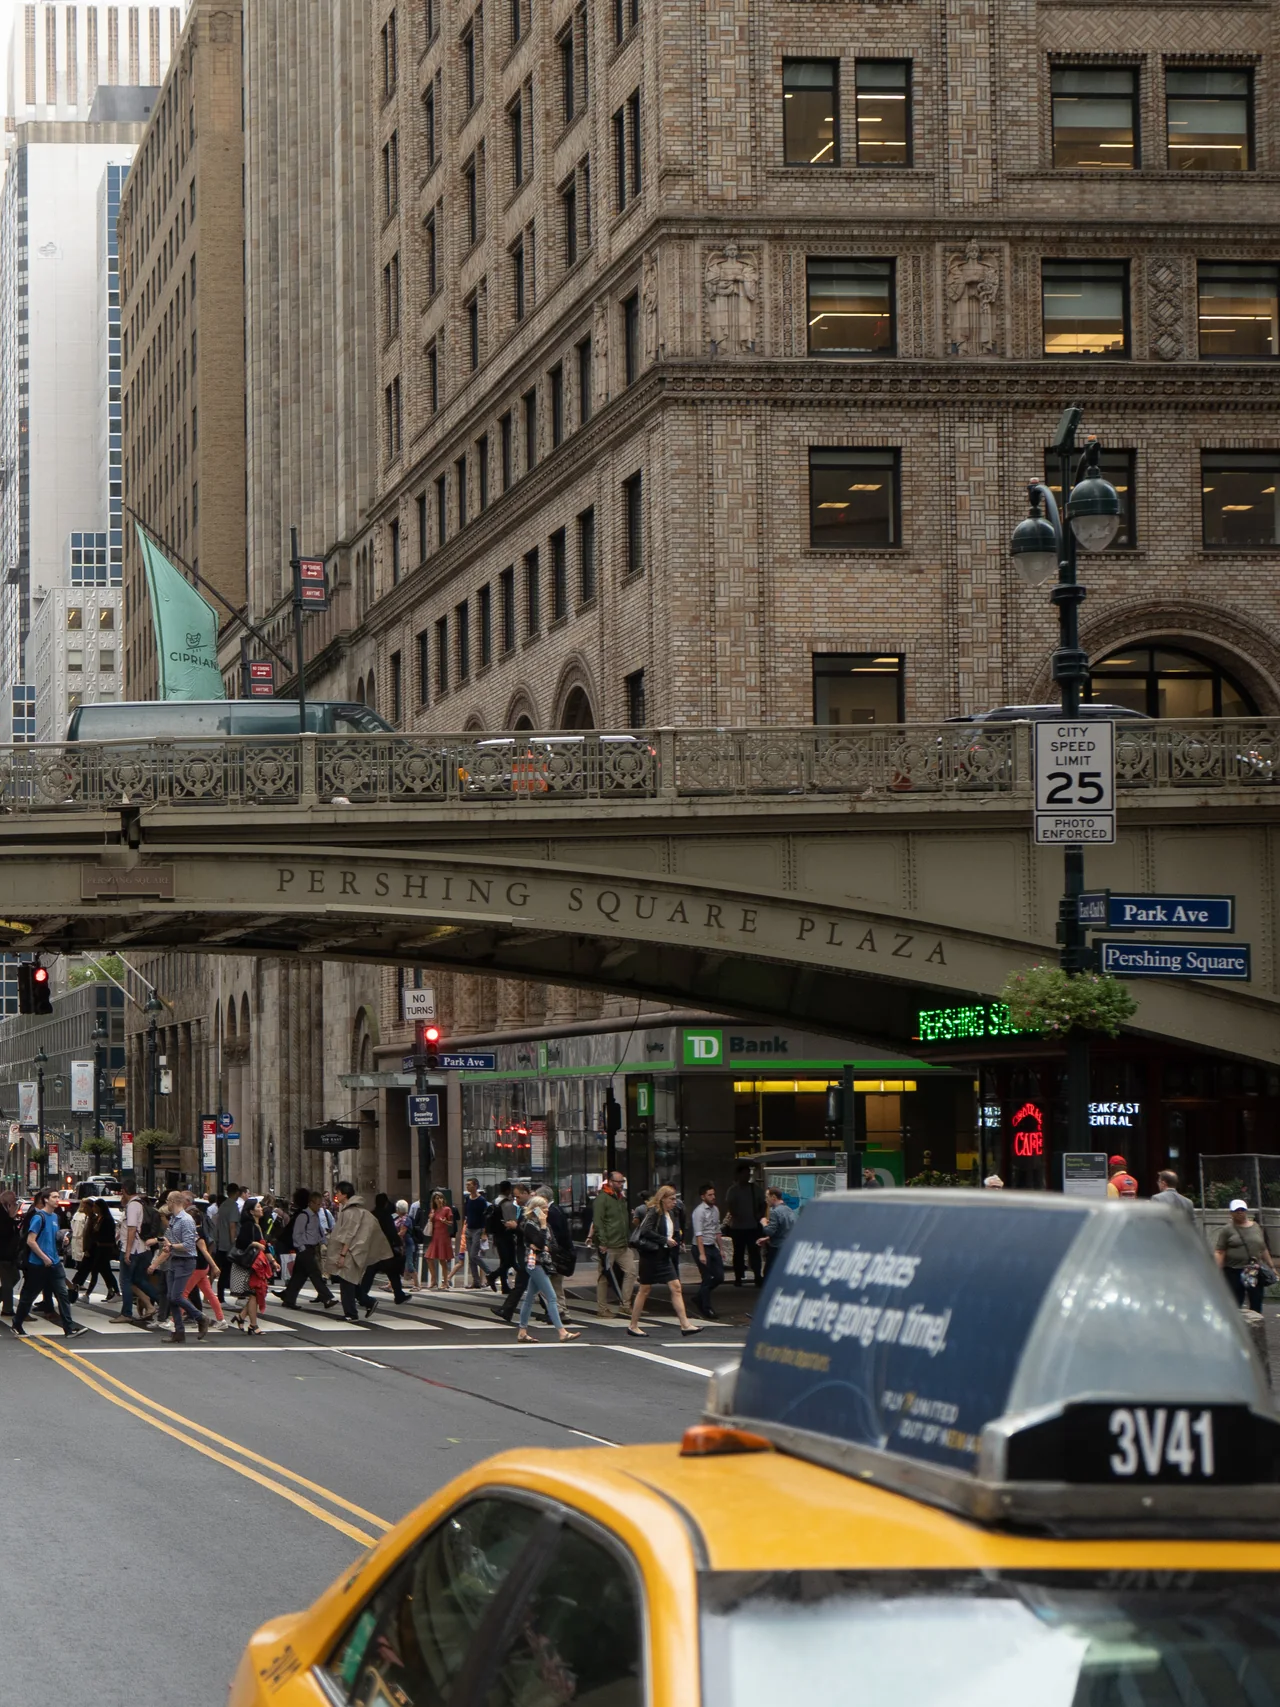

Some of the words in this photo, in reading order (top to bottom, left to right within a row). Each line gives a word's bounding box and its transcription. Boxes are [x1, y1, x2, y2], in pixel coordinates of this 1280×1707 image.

[1057, 727, 1088, 737] CITY
[1050, 742, 1096, 752] SPEED
[1056, 756, 1091, 766] LIMIT
[1046, 772, 1104, 804] 25
[1055, 819, 1095, 828] PHOTO
[1043, 829, 1107, 839] ENFORCED
[135, 877, 170, 885] SQUARE
[276, 868, 530, 906] PERSHING
[568, 887, 758, 933] SQUARE
[796, 916, 948, 966] PLAZA
[1124, 904, 1168, 922] Park
[1172, 906, 1208, 922] Ave
[1107, 949, 1182, 971] Pershing
[1186, 952, 1244, 972] Square
[412, 994, 426, 1003] NO
[406, 1006, 433, 1015] TURNS
[919, 1006, 984, 1040] PERSHING
[687, 1036, 719, 1058] TD
[730, 1036, 788, 1053] Bank
[444, 1057, 464, 1066] Park
[467, 1058, 484, 1066] Ave
[1015, 1131, 1043, 1156] CAFE
[784, 1240, 831, 1279] We're
[820, 1244, 870, 1289] going
[860, 1246, 921, 1290] places
[795, 1293, 839, 1334] we're
[830, 1297, 882, 1347] going
[875, 1308, 904, 1344] on
[1109, 1408, 1214, 1476] 3V41
